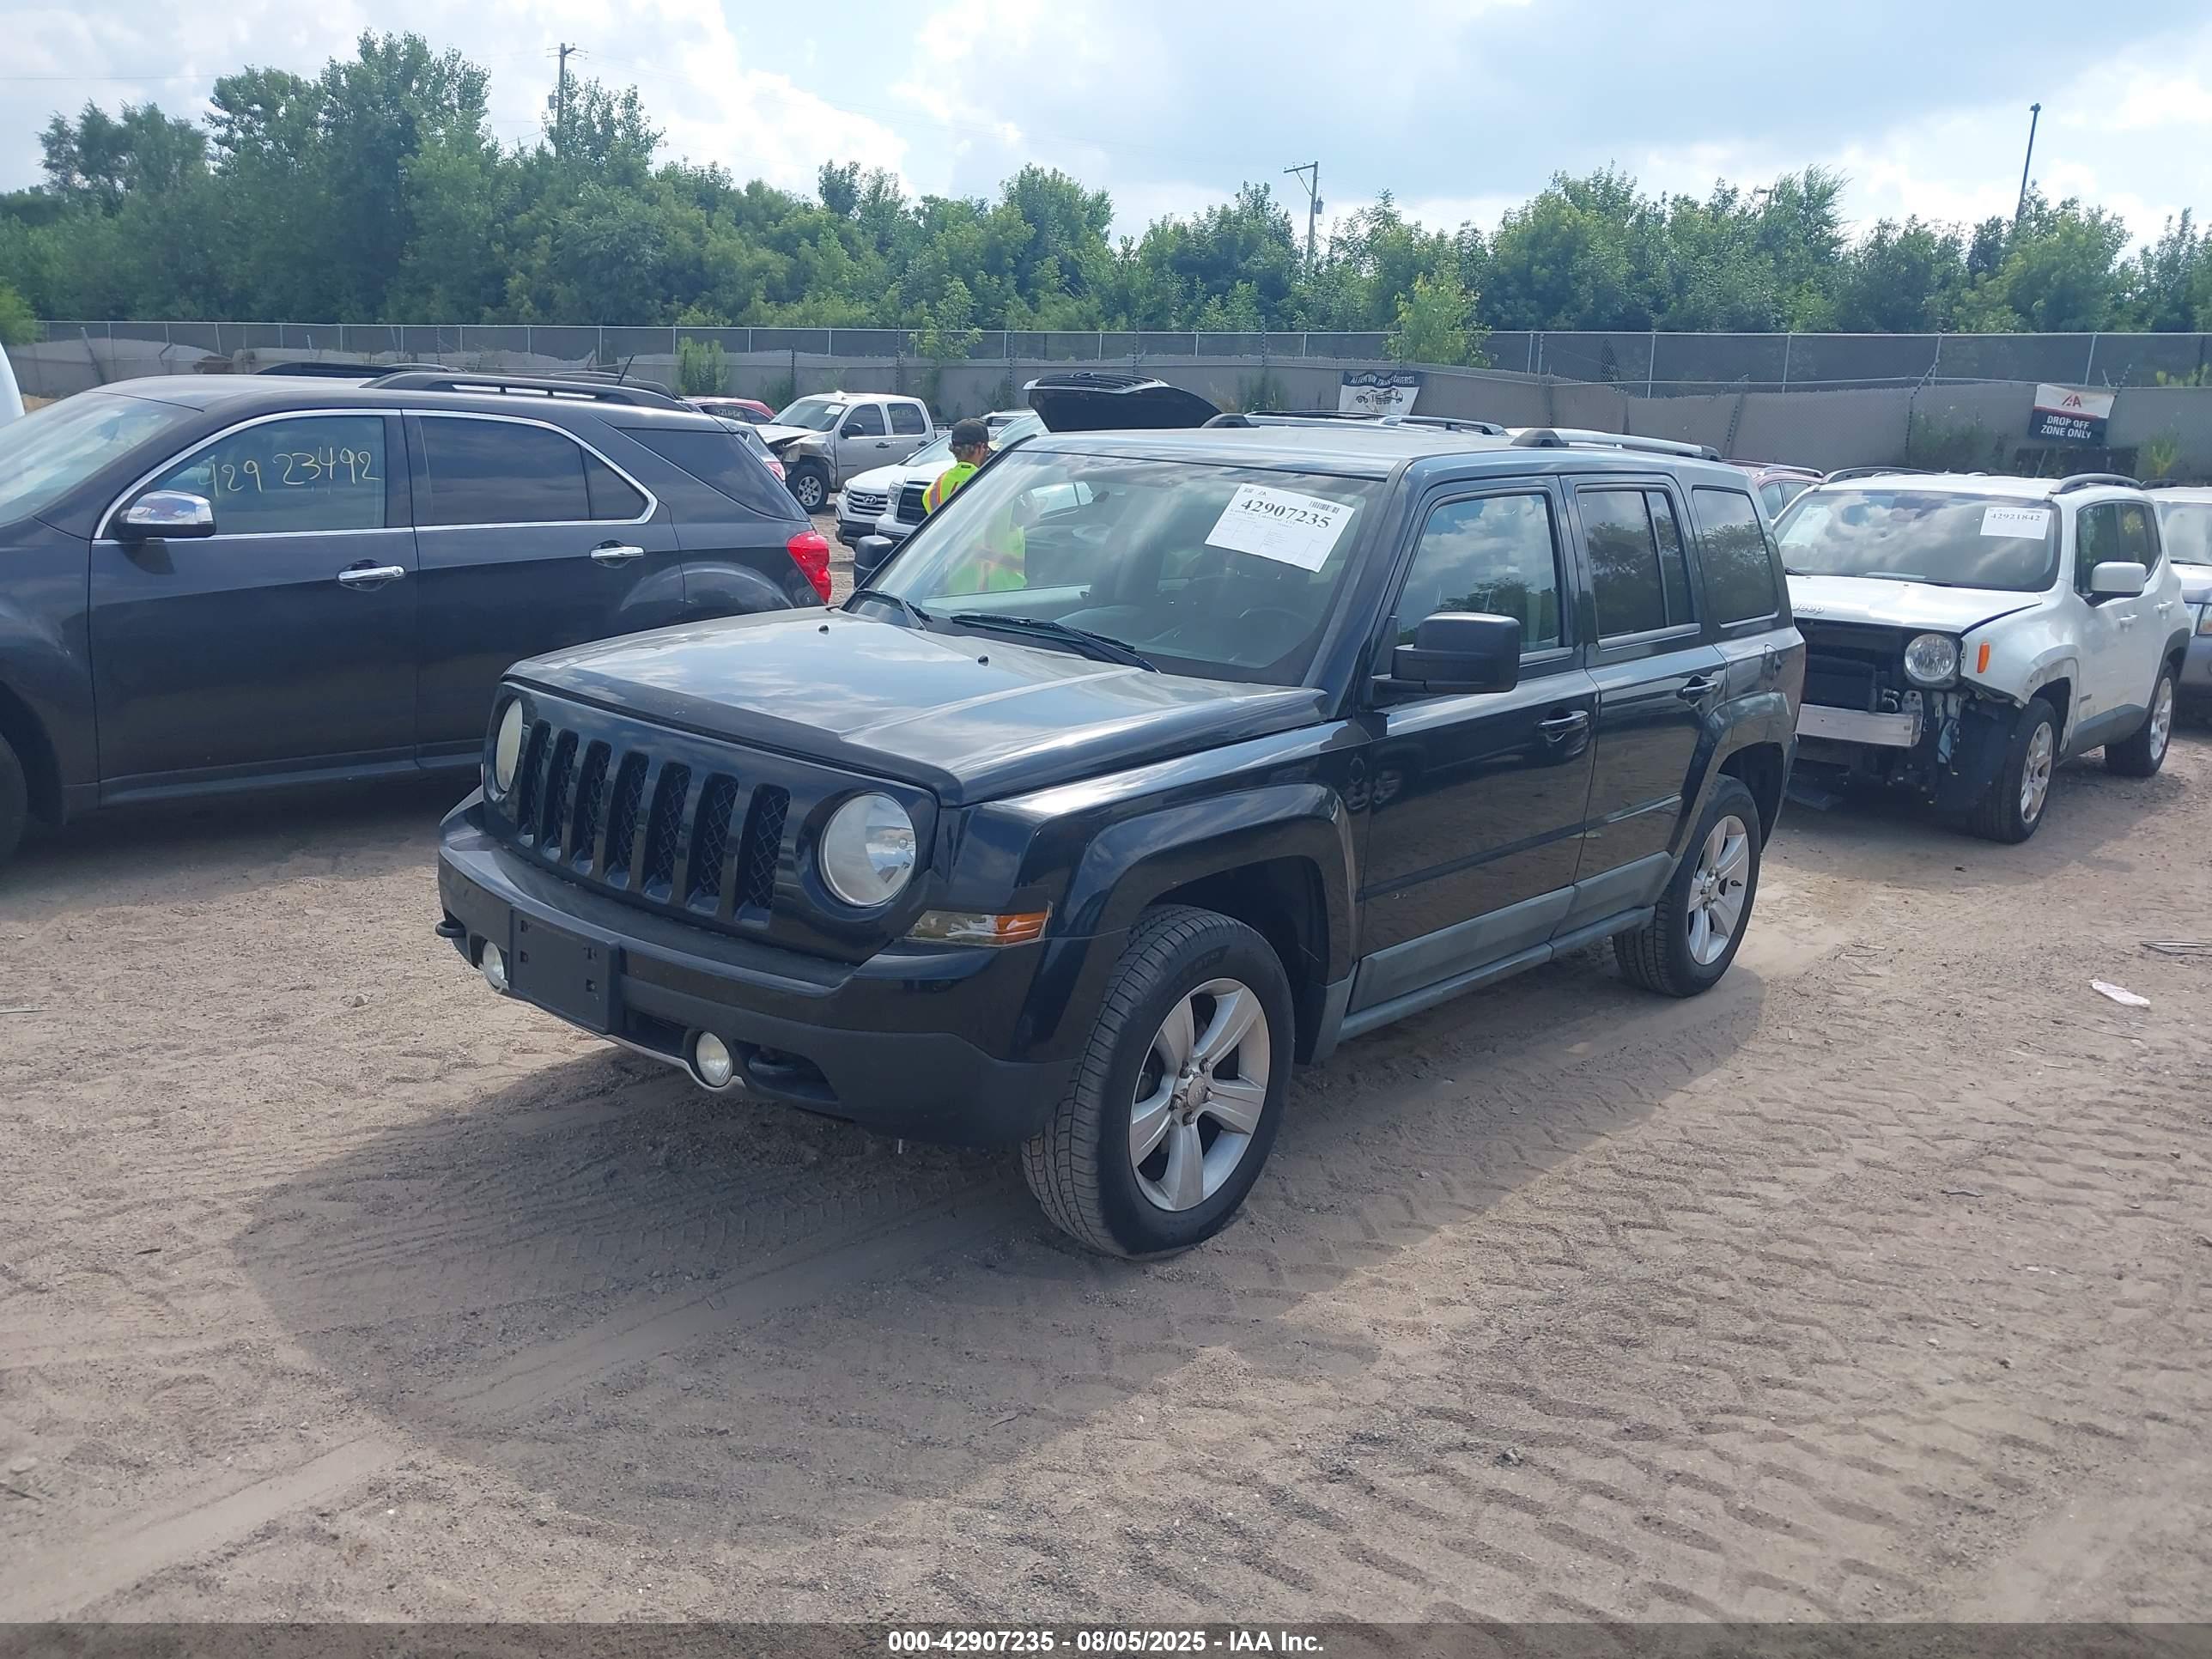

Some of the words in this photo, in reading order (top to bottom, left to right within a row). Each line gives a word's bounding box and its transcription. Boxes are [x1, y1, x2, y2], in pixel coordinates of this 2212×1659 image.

[2046, 415, 2071, 426] DROP
[2073, 419, 2090, 429] OFF
[2040, 424, 2065, 436] ZONE
[2067, 428, 2091, 439] ONLY
[272, 447, 381, 485] 23492
[1241, 499, 1332, 529] 42907235
[1791, 604, 1825, 615] Jeep
